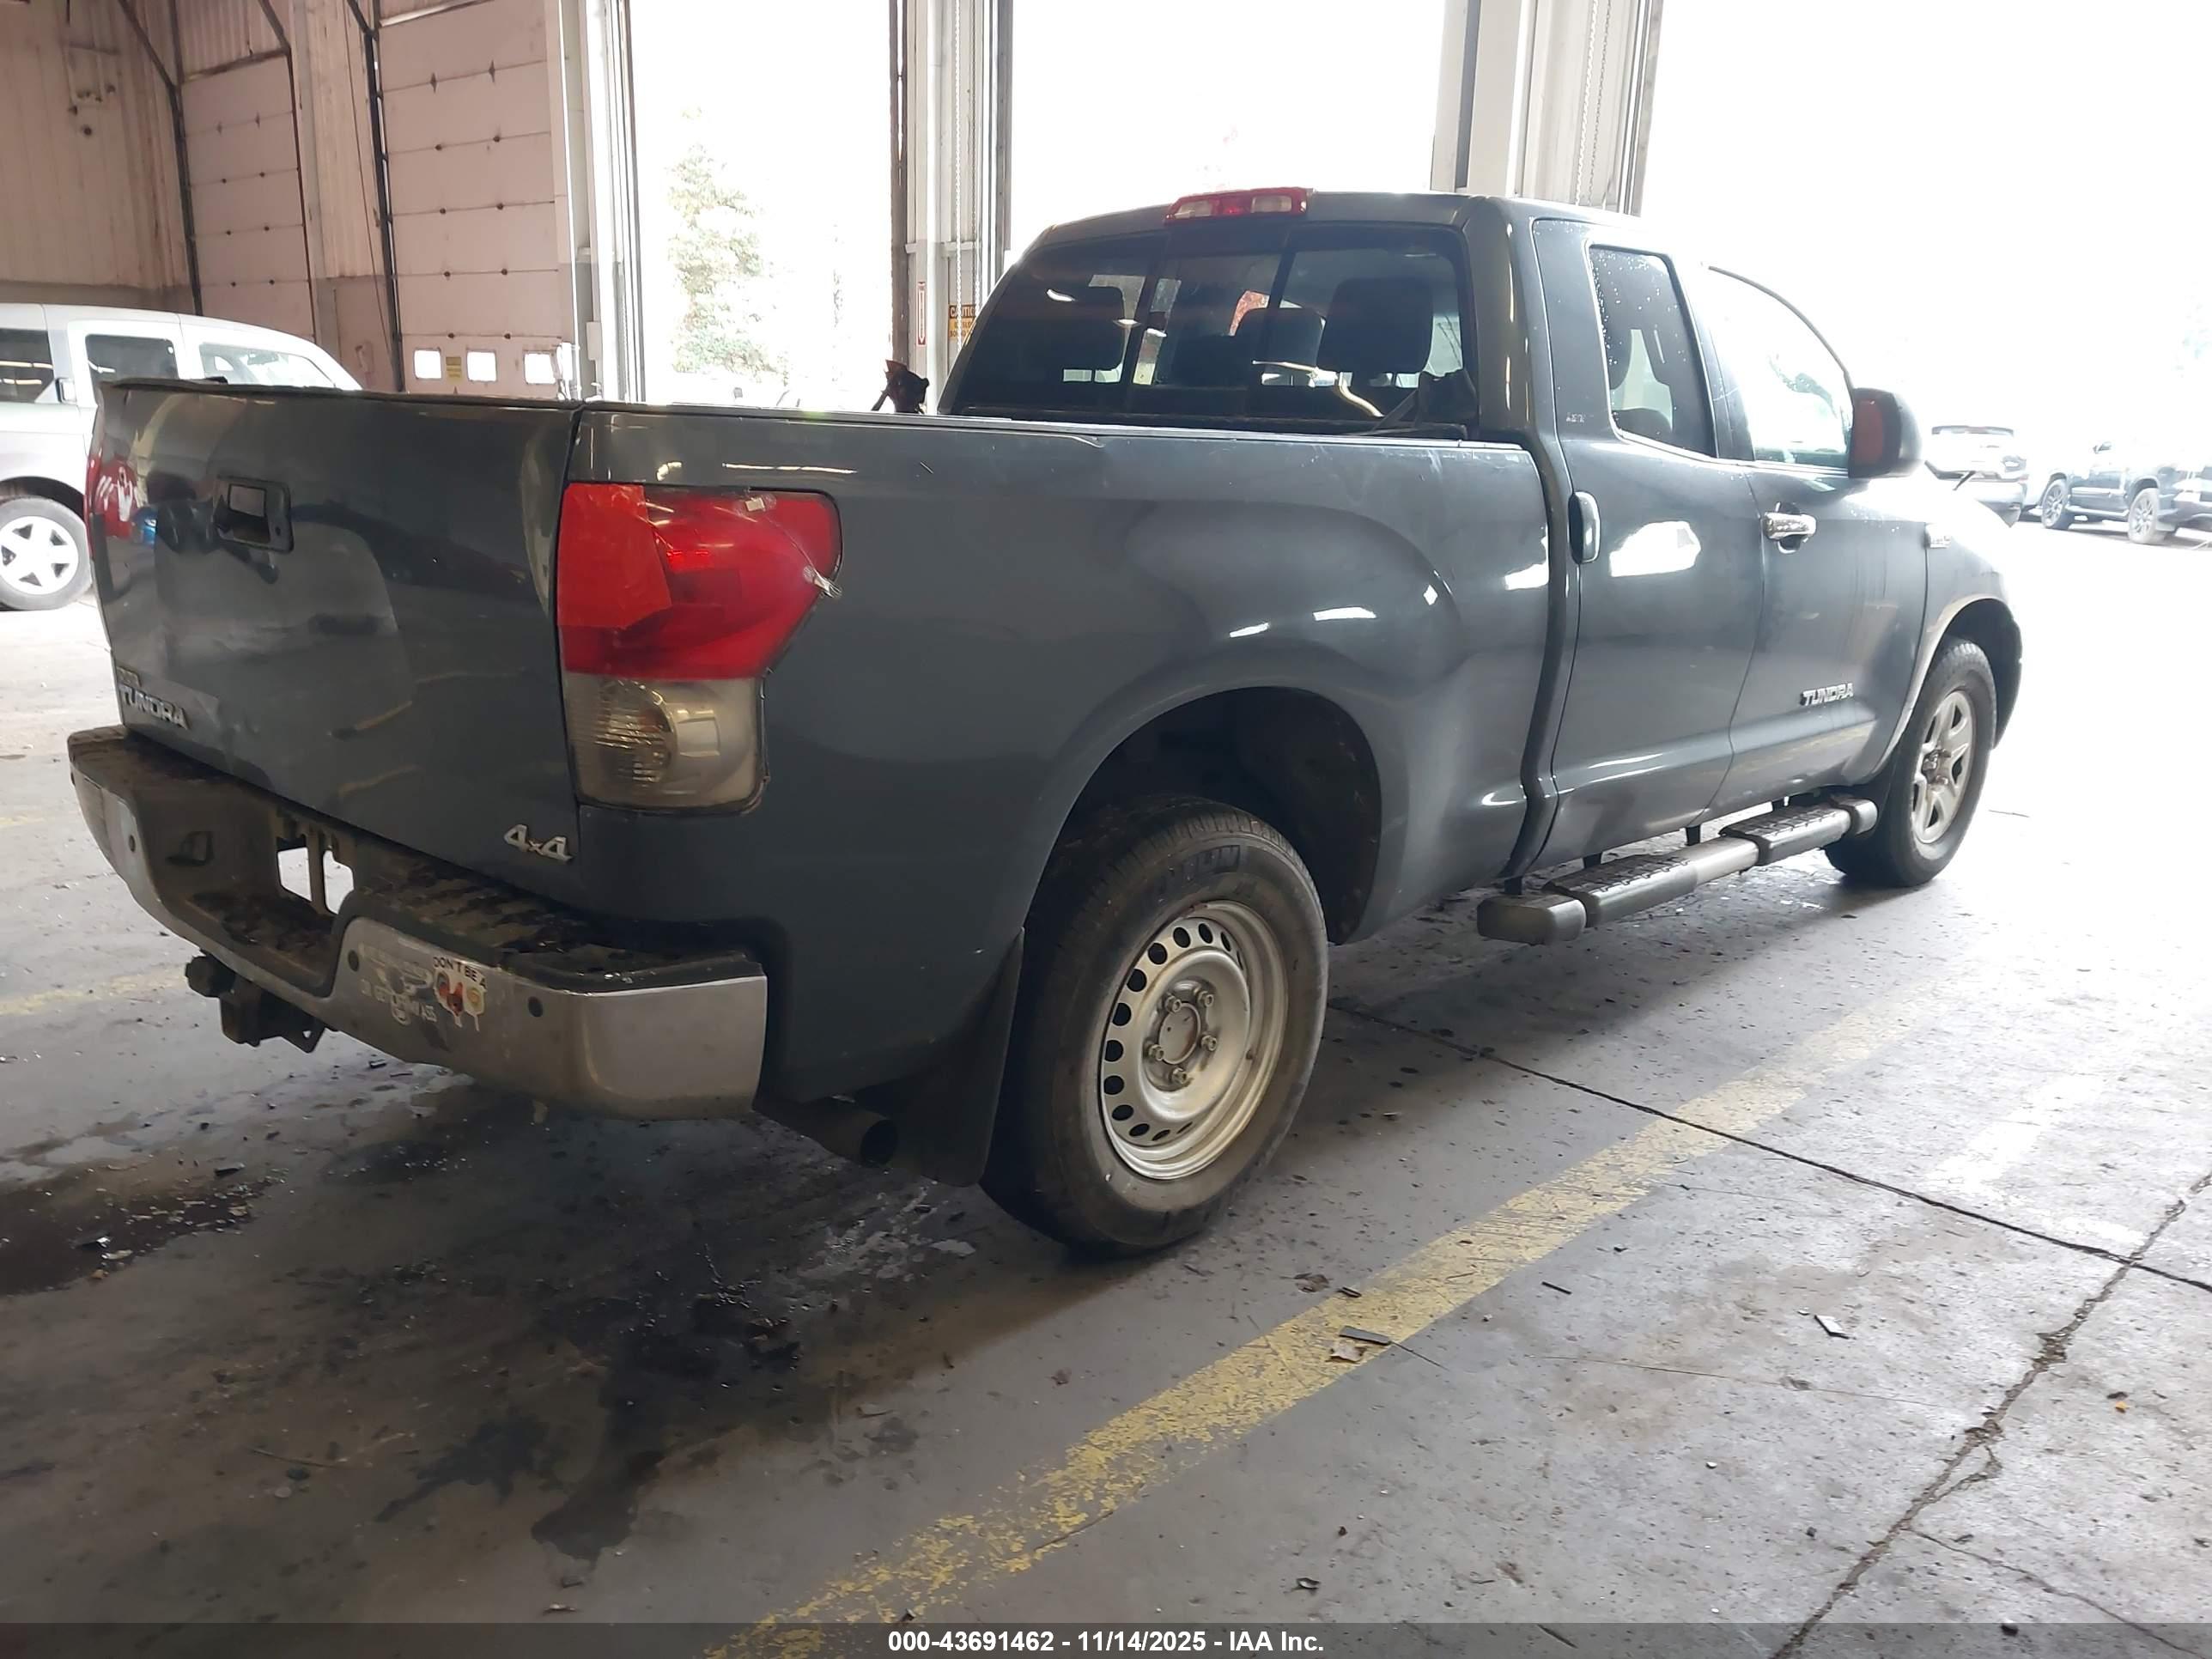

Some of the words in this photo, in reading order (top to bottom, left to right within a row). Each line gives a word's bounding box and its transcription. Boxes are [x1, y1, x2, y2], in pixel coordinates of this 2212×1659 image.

[118, 684, 188, 730] TUNDRA
[1802, 683, 1854, 706] TUNDRA
[503, 823, 574, 861] 4x4
[433, 957, 462, 973] DONT
[465, 964, 477, 982] BE
